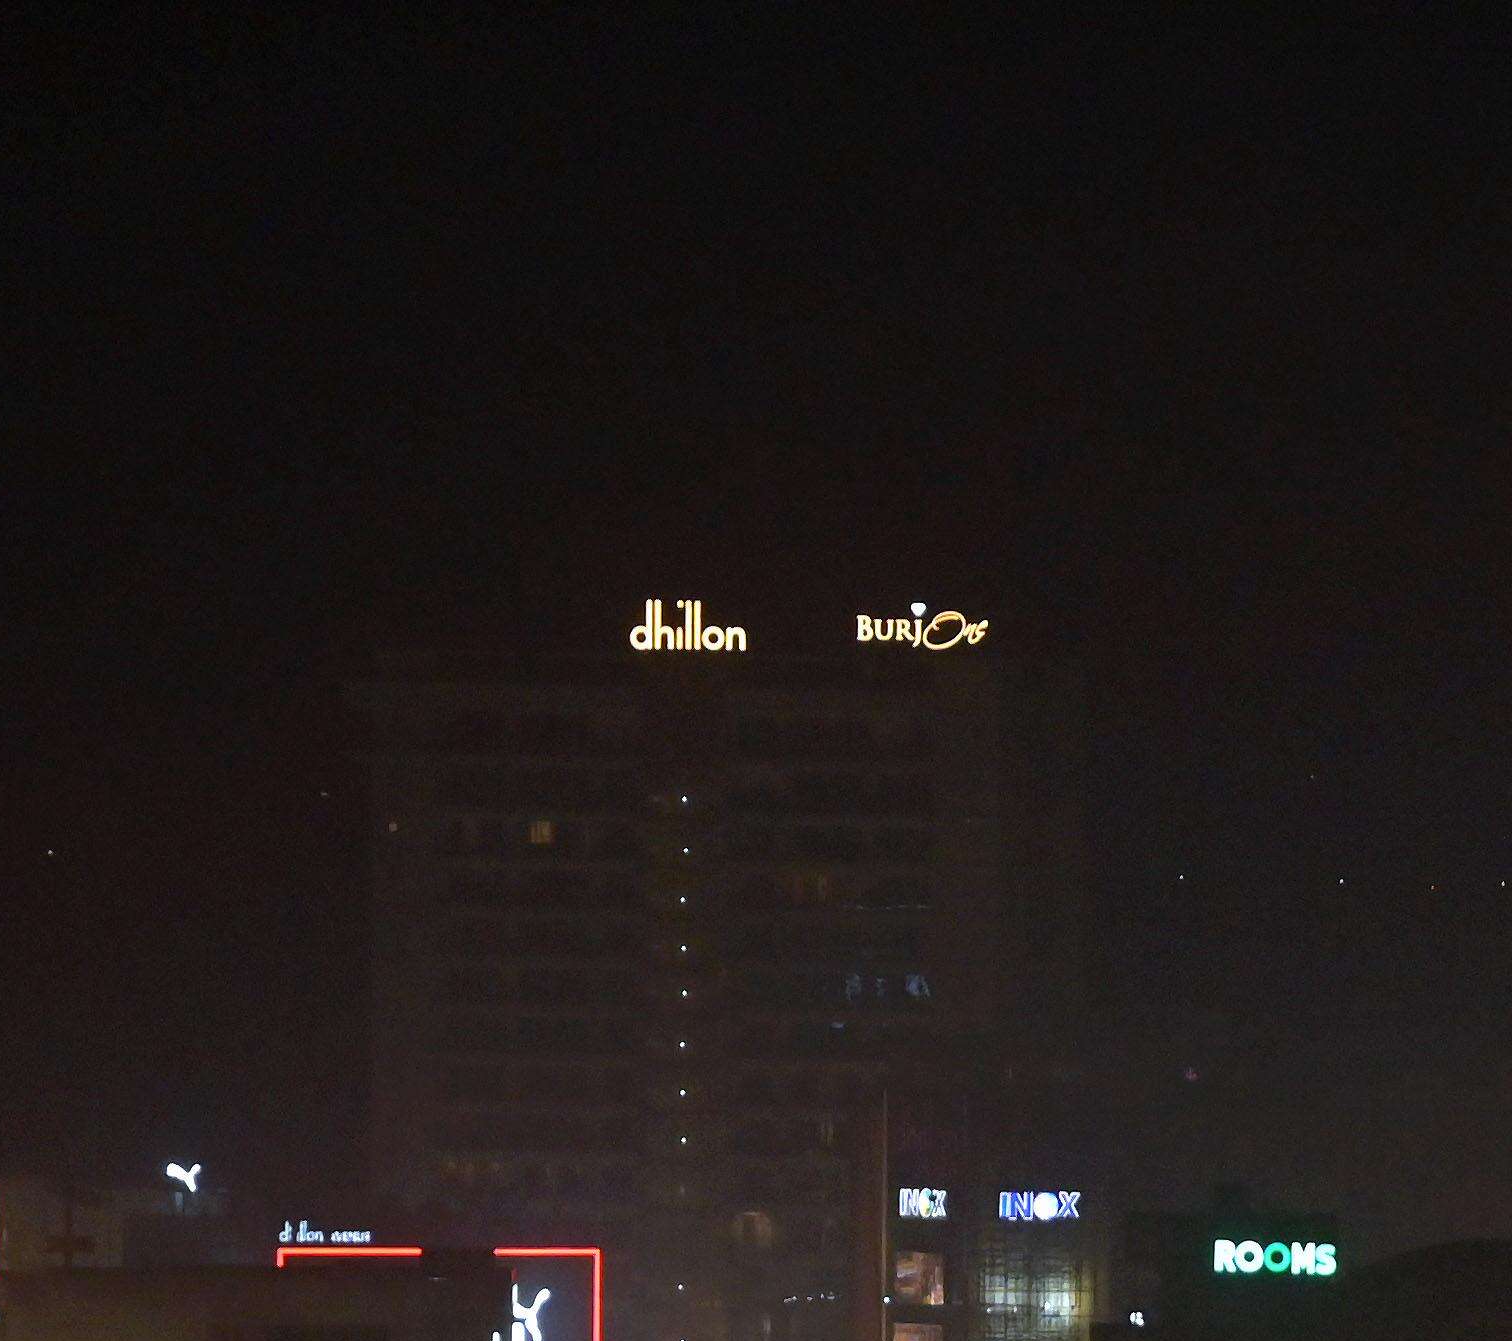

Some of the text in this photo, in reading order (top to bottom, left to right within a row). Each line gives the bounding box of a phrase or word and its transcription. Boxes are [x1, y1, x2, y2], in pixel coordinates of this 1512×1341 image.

[630, 599, 747, 651] dhillon
[899, 1188, 947, 1218] INOX
[999, 1191, 1082, 1220] INOX
[1214, 1239, 1337, 1275] ROOMS
